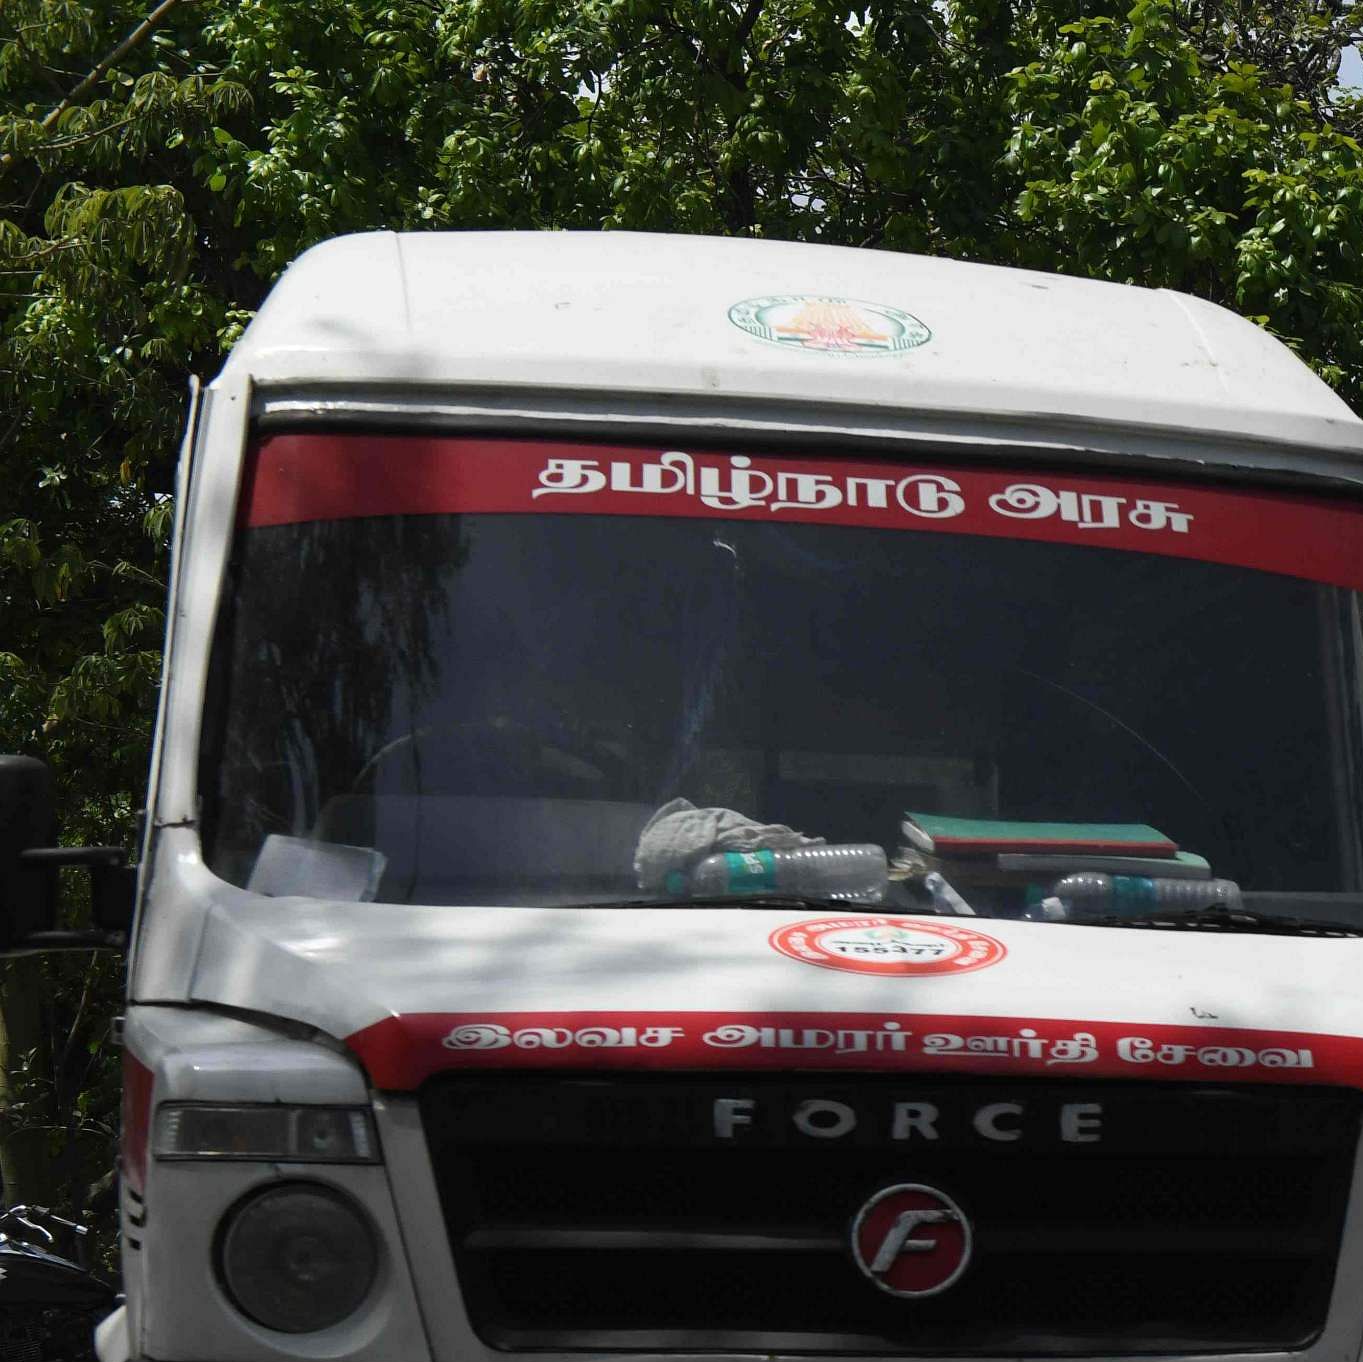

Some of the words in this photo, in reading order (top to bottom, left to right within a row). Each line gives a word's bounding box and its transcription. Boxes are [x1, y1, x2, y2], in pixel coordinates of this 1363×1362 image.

[531, 450, 966, 518] தமிழ்நாடு
[988, 483, 1195, 533] அரசு
[441, 1023, 686, 1049] இலவச
[702, 1021, 914, 1054] அமரர்
[922, 1028, 1099, 1066] ஊர்தி
[1116, 1036, 1315, 1068] சேவை
[713, 1098, 1103, 1142] FORCE
